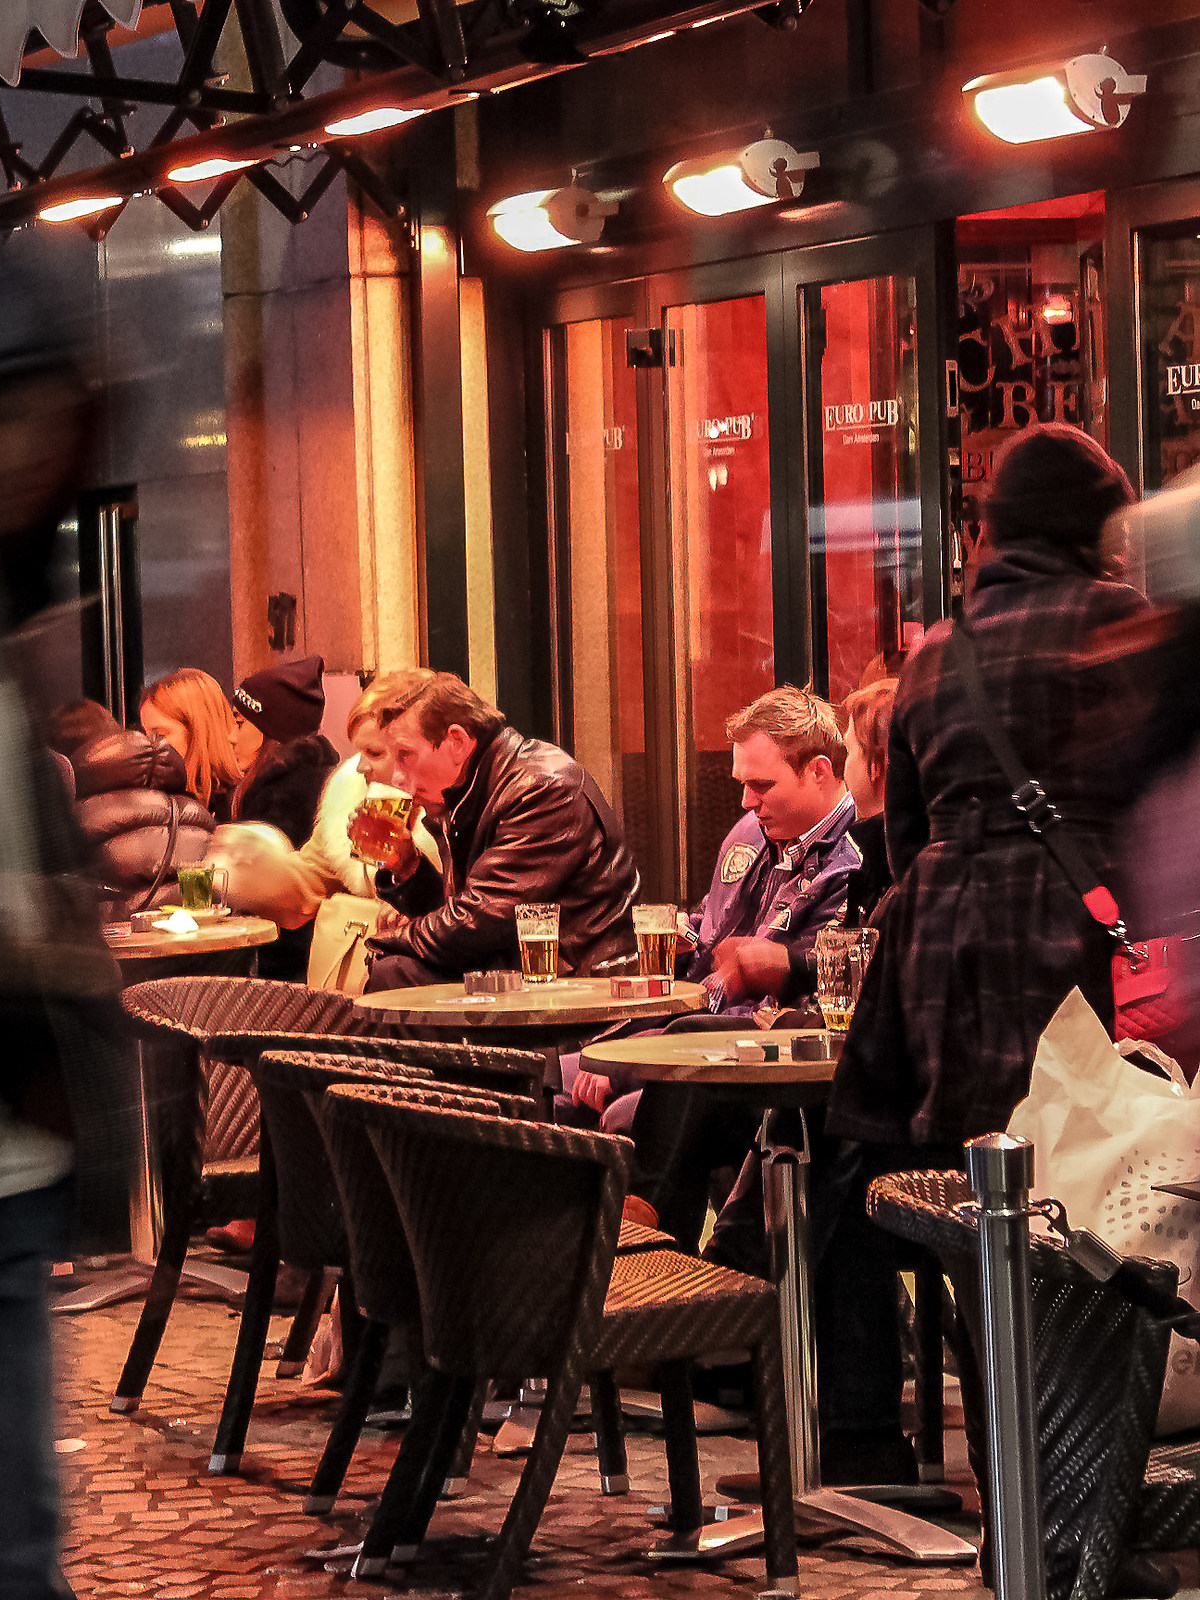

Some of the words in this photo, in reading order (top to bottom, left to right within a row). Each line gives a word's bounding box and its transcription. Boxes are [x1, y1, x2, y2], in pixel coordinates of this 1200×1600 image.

[725, 413, 752, 440] PUB
[825, 403, 864, 431] EURO
[869, 399, 899, 426] PUB
